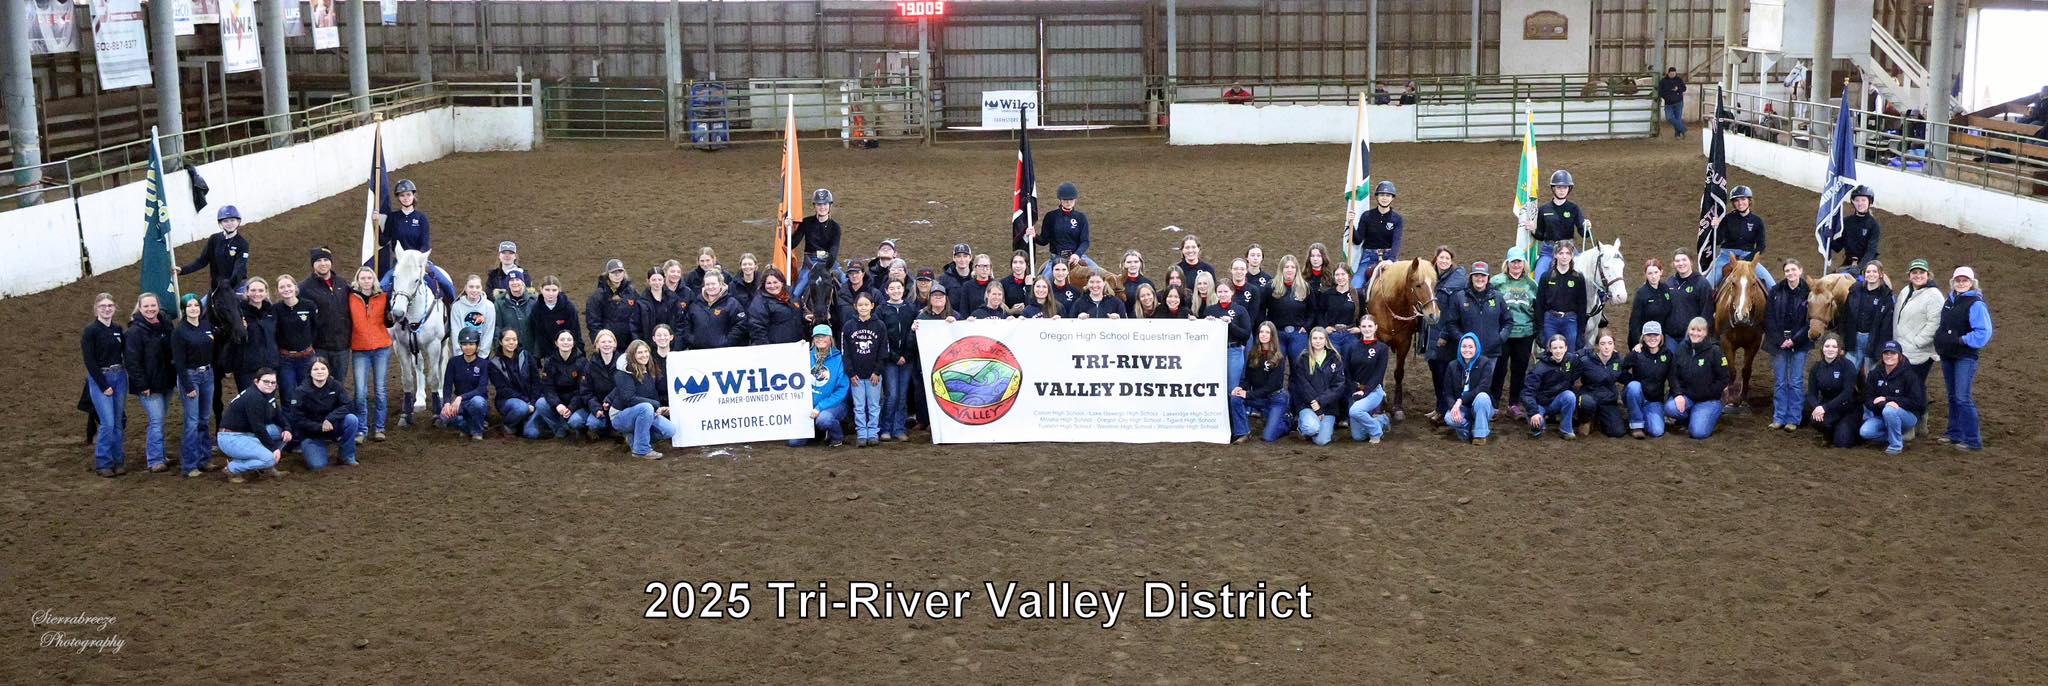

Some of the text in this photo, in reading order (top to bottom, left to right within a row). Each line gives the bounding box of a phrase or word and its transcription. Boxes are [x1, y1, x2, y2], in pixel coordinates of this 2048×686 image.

[1000, 100, 1036, 110] Wilco
[1040, 331, 1208, 342] Oregon High School Equestrian Team
[1072, 355, 1182, 369] TRI-RIVER
[712, 368, 805, 394] Wilco
[1034, 382, 1114, 396] VALLEY
[1119, 383, 1219, 397] DISTRICT
[718, 396, 769, 405] FARMER-OWNED
[701, 414, 792, 431] FARMSTORE.COM
